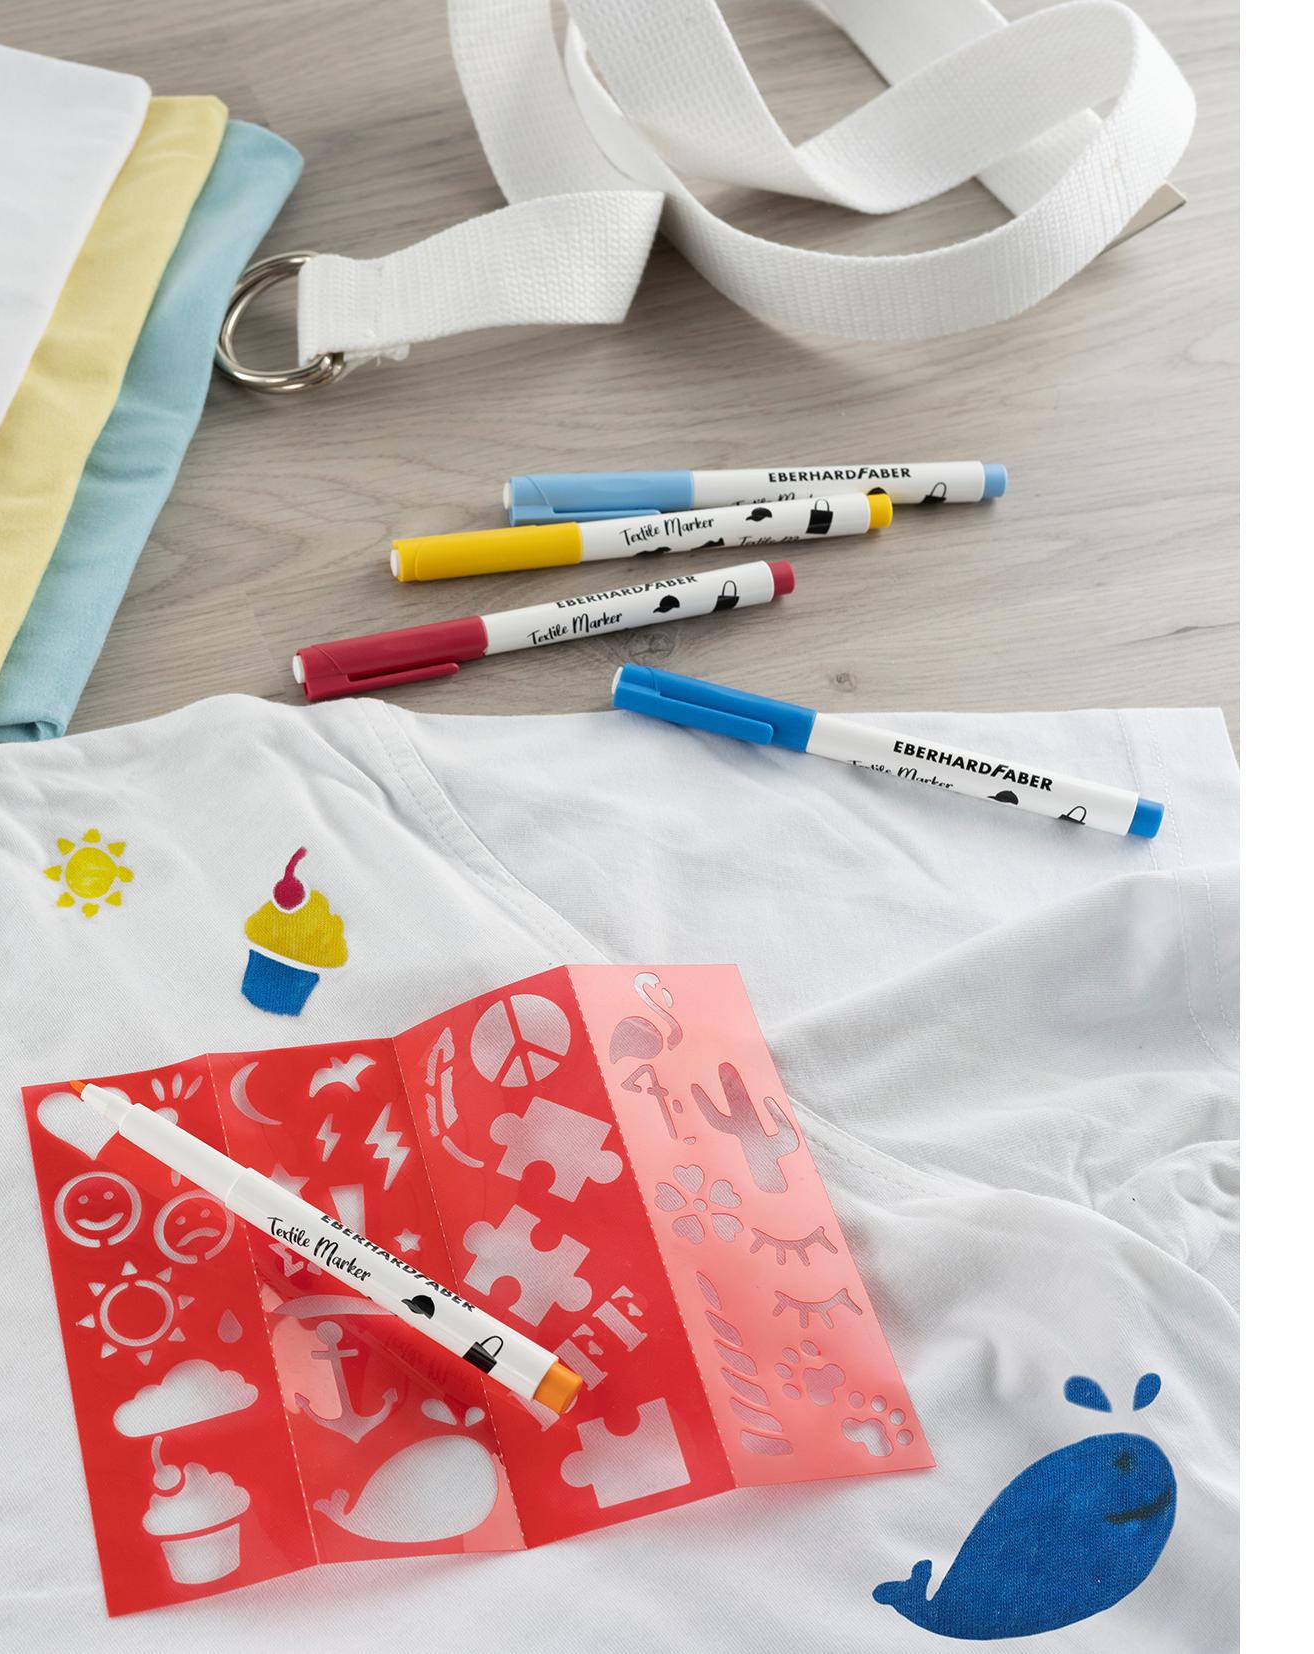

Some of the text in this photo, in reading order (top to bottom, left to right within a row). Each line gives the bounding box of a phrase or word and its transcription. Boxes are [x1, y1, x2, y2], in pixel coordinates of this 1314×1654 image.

[768, 467, 912, 483] EBERHARDFABER
[619, 516, 715, 547] Textile Marker
[526, 611, 623, 646] Textile Marker
[892, 740, 1053, 792] EBERHARDFABER
[266, 1216, 372, 1283] Textile Marker
